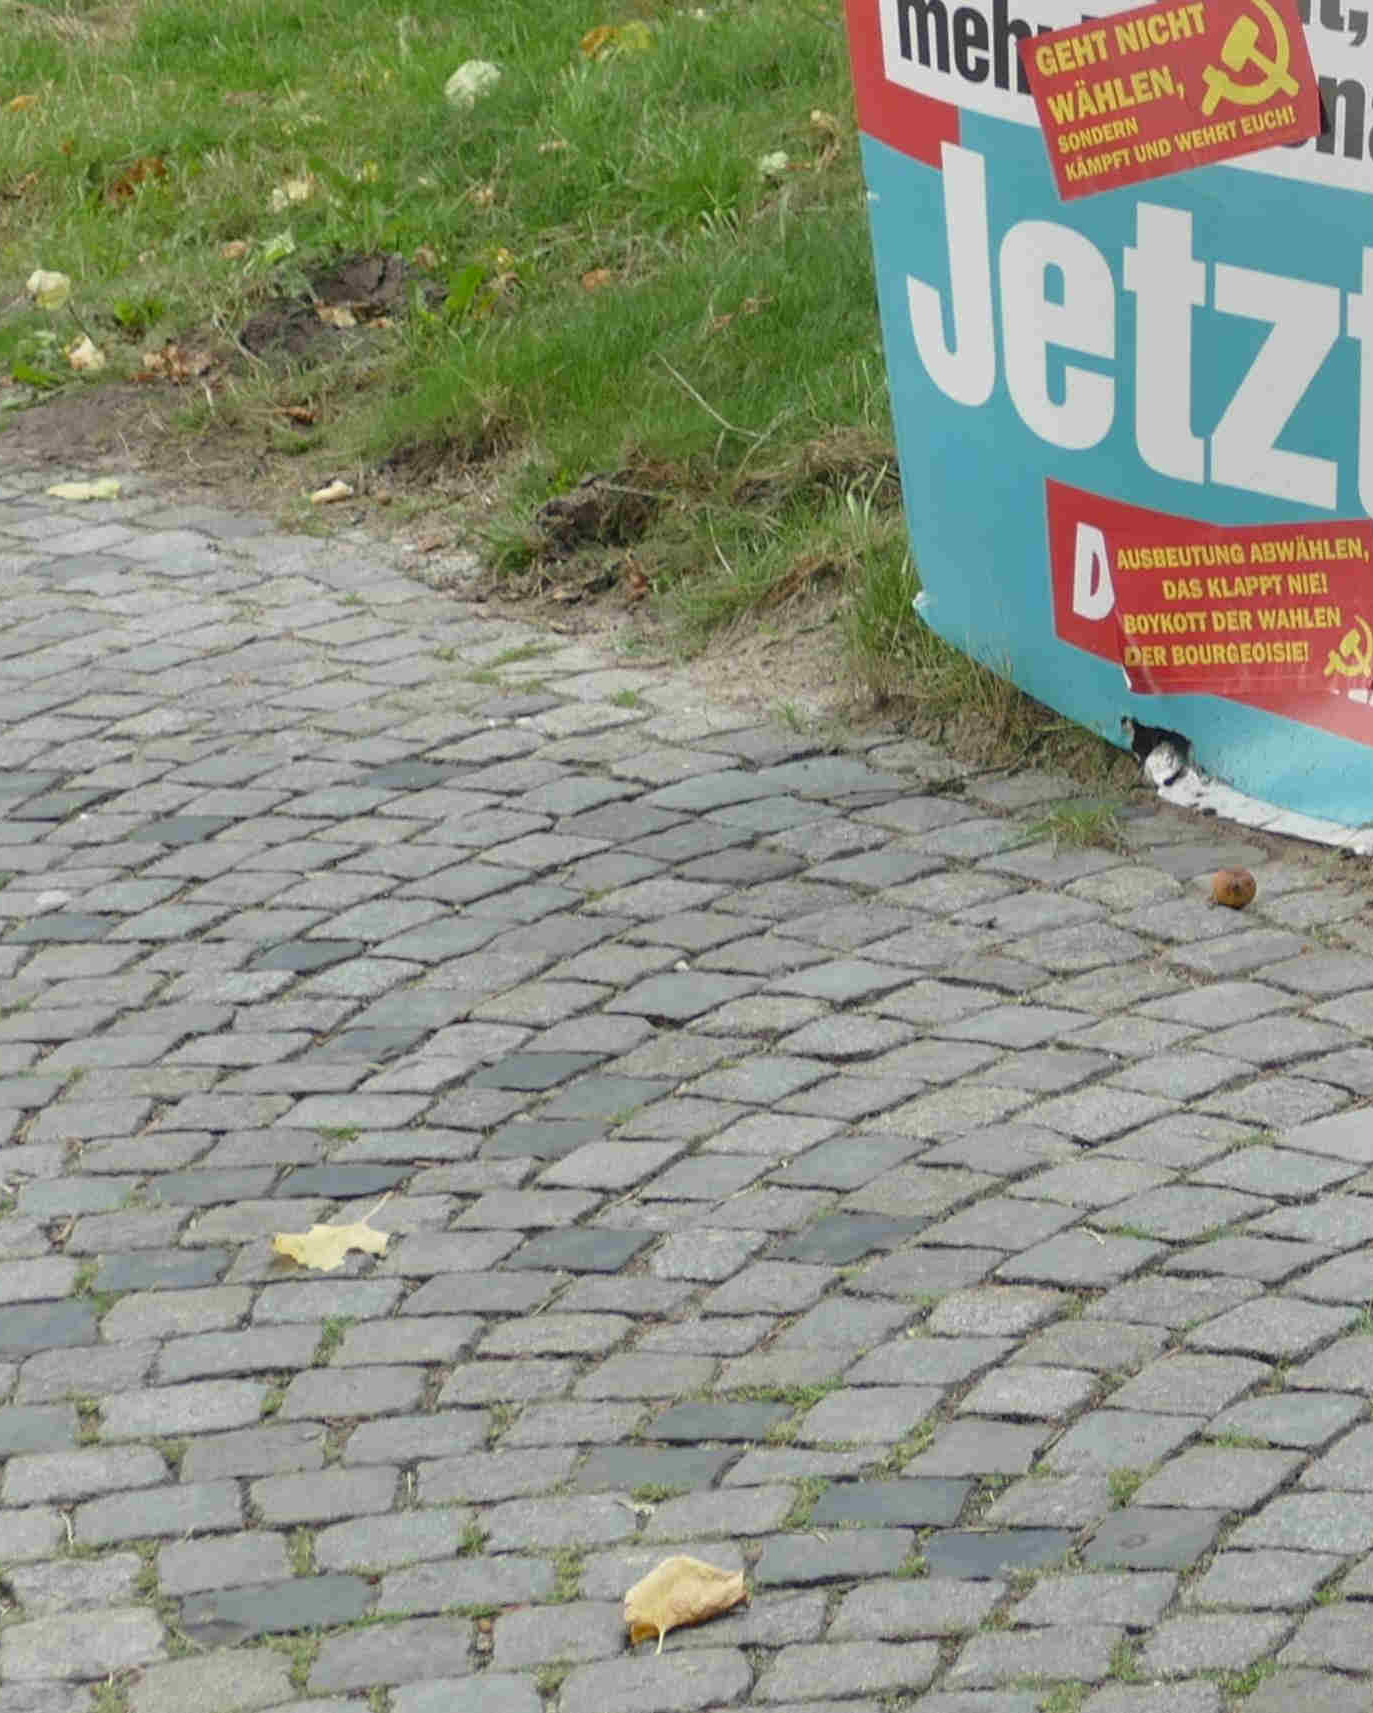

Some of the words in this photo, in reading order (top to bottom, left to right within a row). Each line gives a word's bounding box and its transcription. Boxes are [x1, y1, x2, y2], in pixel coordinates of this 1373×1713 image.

[1035, 30, 1108, 77] GEHT
[1114, 2, 1206, 55] NICHT
[1047, 66, 1187, 124] WÄHLEN,
[1056, 116, 1139, 154] SONDERN
[1064, 147, 1131, 182] KÄMPFT
[1134, 137, 1173, 164] UND
[1175, 120, 1239, 154] WEHRT
[1240, 104, 1297, 134] EUCH!
[1117, 539, 1247, 571] AUSBEUTUNG
[1250, 536, 1370, 564] ABWÄHLEN,
[1162, 578, 1204, 602] DAS
[1206, 574, 1285, 599] KLAPPT
[1288, 572, 1329, 594] NIE!
[1123, 609, 1207, 636] BOYKOTT
[1211, 608, 1254, 634] DER
[1257, 606, 1342, 630] WAHLEN
[1124, 643, 1168, 668] DER
[1171, 639, 1310, 666] BOURGEOISIE!
